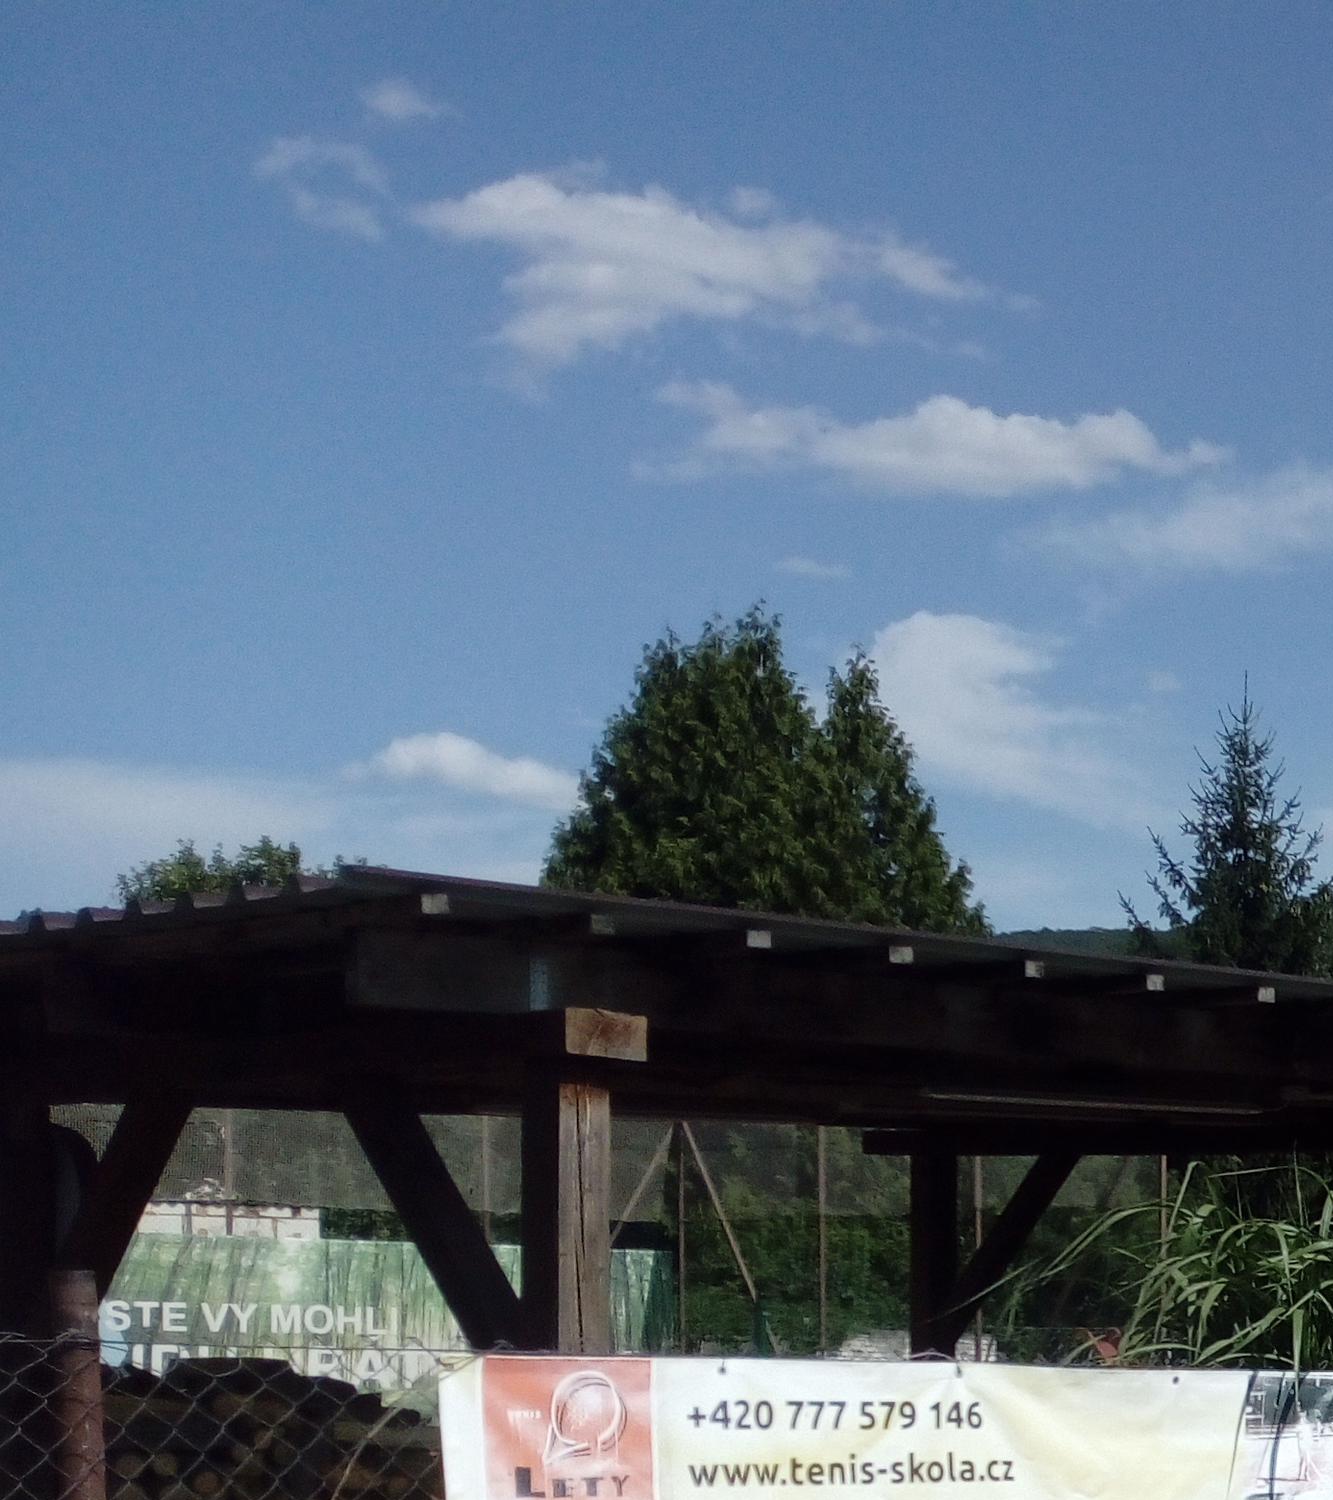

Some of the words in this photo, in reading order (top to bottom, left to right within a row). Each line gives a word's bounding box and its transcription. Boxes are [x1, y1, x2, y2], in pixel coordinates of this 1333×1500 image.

[200, 1302, 259, 1334] VY
[270, 1303, 399, 1336] MOHLI
[687, 1400, 774, 1430] +420
[787, 1400, 846, 1430] 777
[859, 1400, 916, 1430] 579
[930, 1400, 983, 1430] 146
[514, 1466, 630, 1498] LETY
[688, 1451, 1016, 1487] www.tenis-skola.cz
